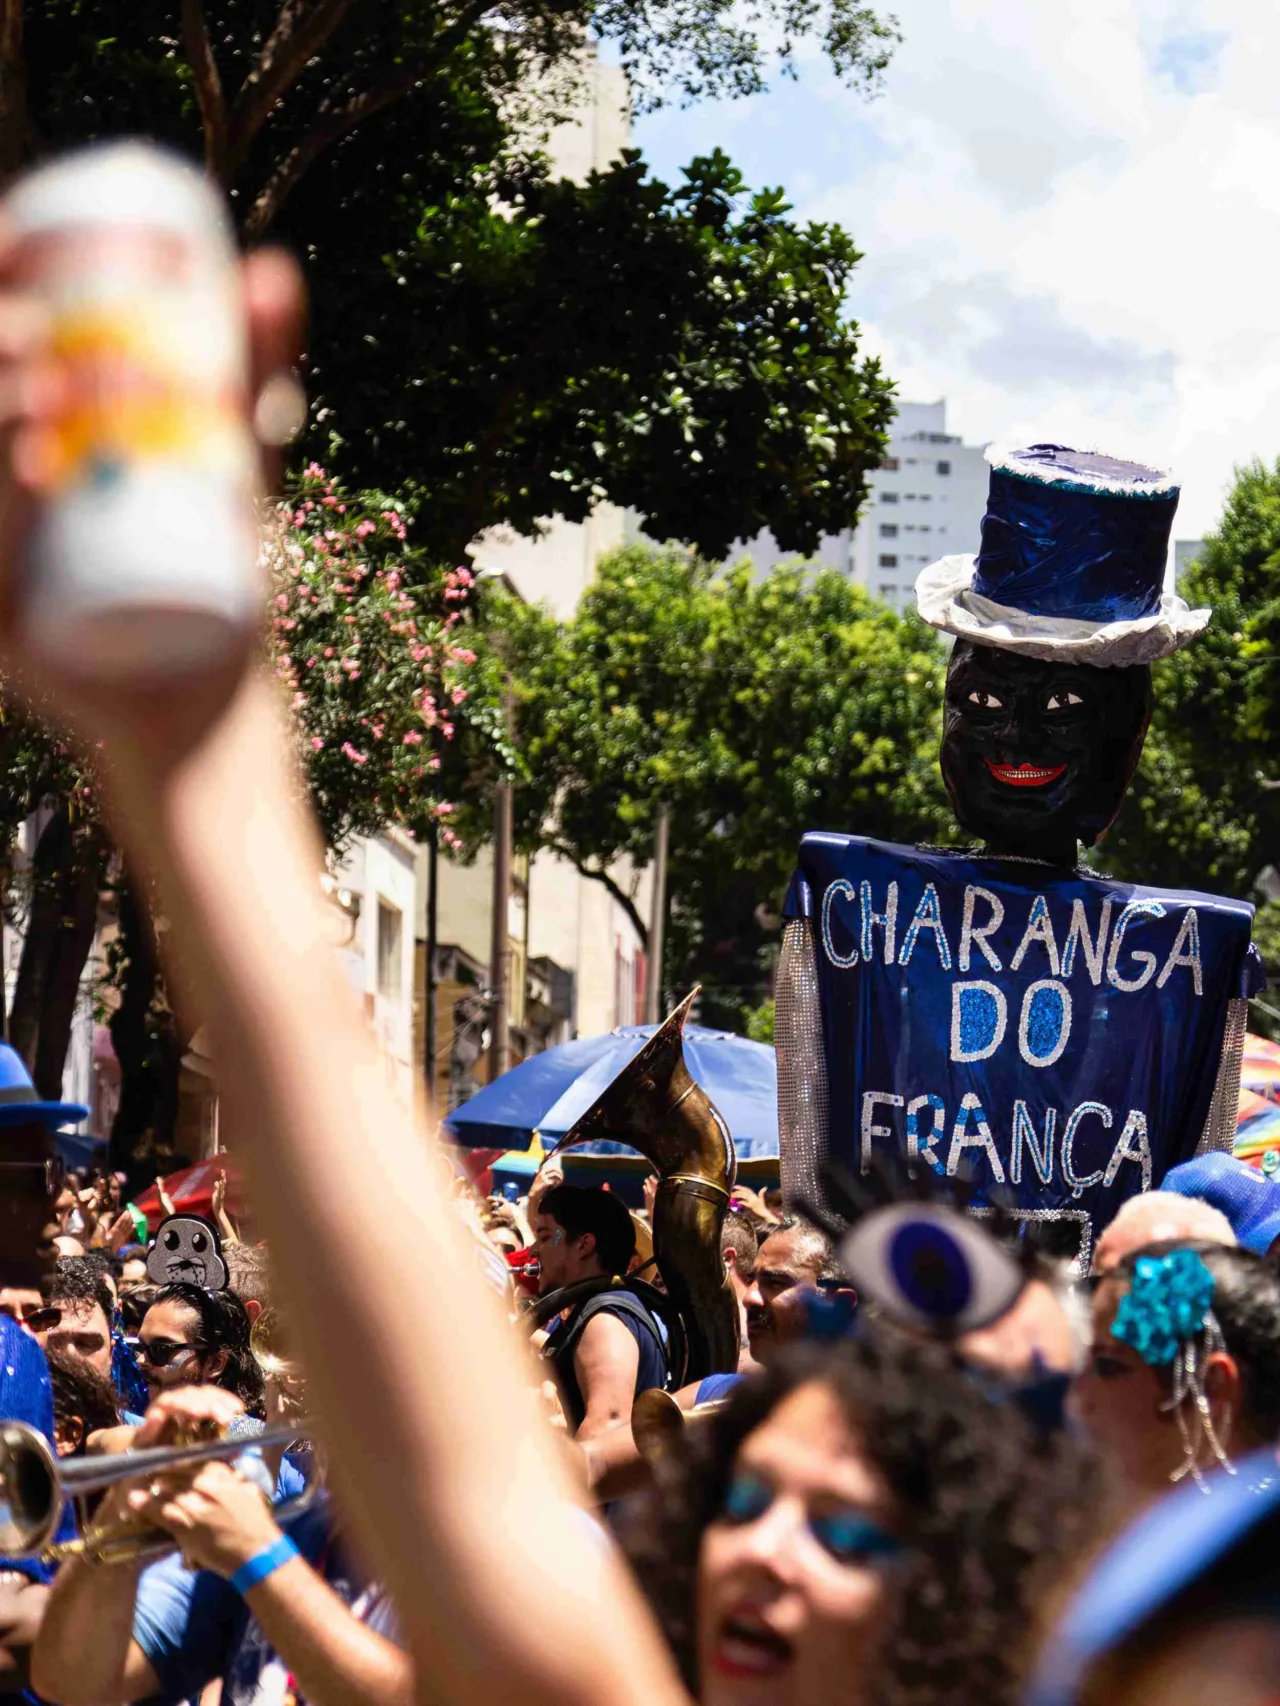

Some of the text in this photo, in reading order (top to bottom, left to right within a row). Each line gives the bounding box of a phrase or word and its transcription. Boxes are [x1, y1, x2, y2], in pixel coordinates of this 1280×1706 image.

[821, 878, 1204, 996] CHARANGA
[950, 979, 1073, 1068] DO
[860, 1092, 1153, 1199] FRANÇA
